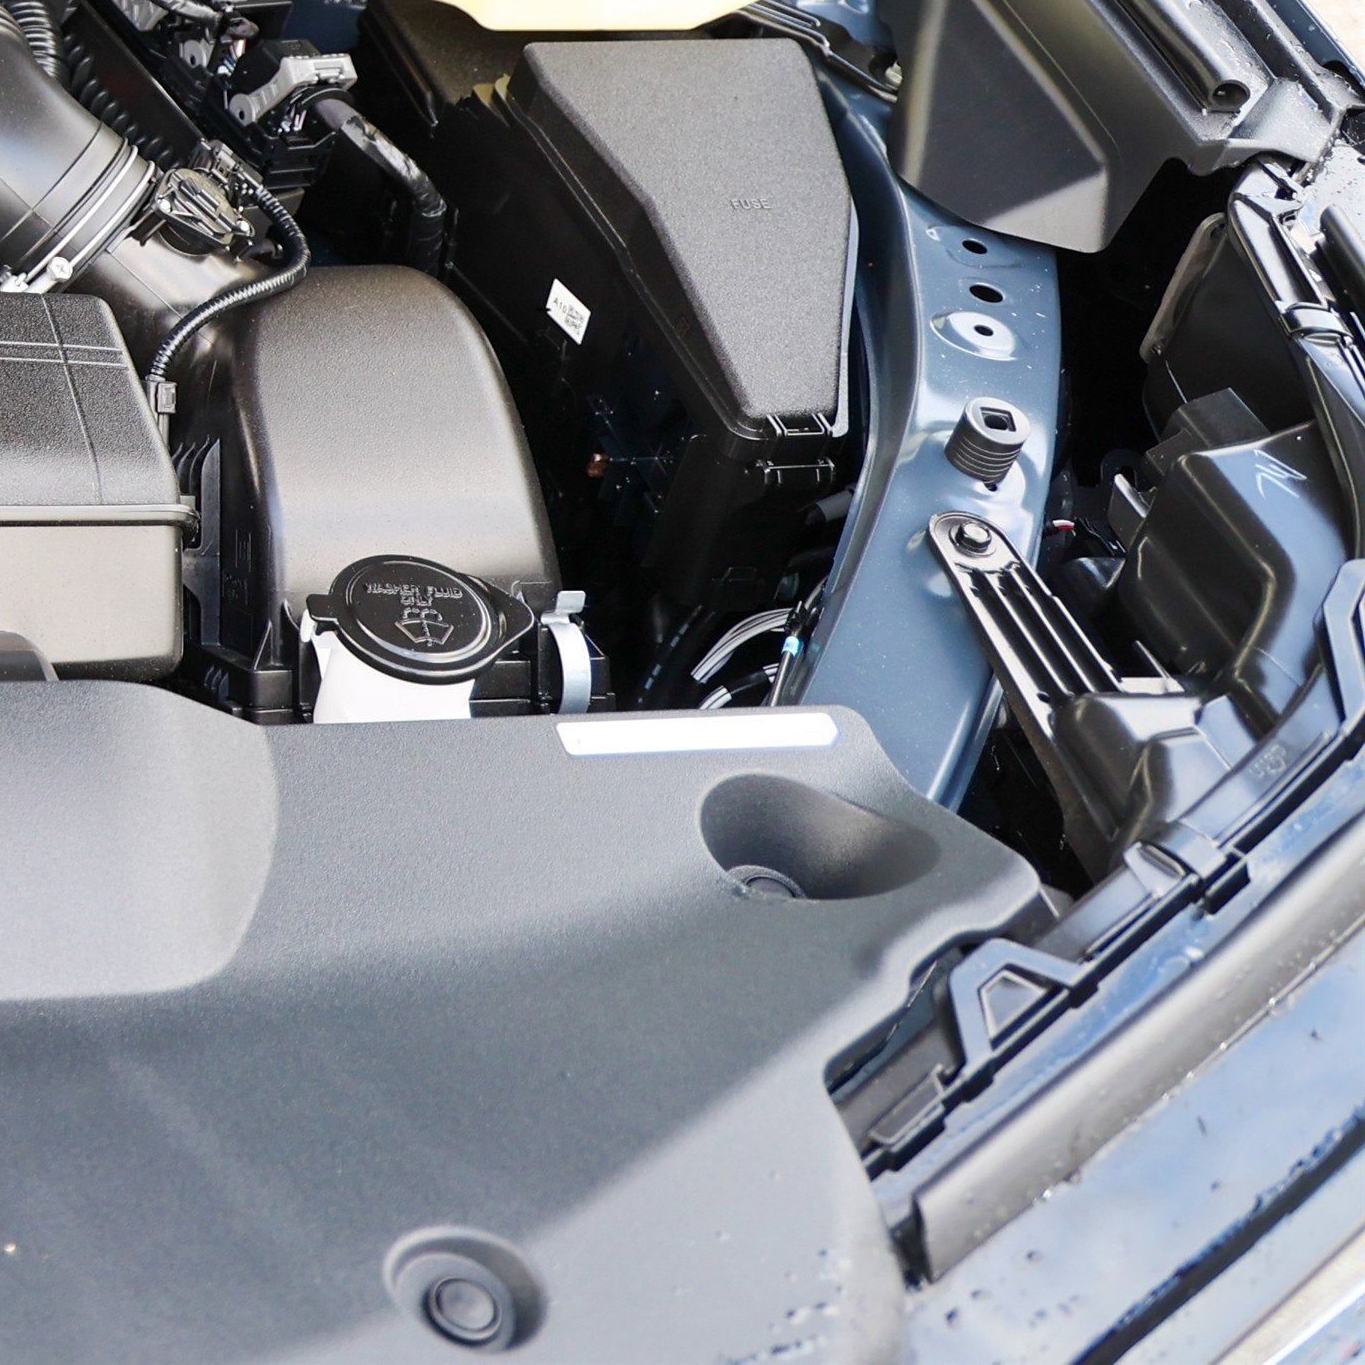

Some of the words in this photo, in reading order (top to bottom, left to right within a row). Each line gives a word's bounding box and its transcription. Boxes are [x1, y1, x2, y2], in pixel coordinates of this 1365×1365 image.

[729, 197, 773, 211] FUSE
[364, 581, 421, 597] WASHER
[426, 585, 463, 599] FLUID
[400, 594, 433, 607] ONLY
